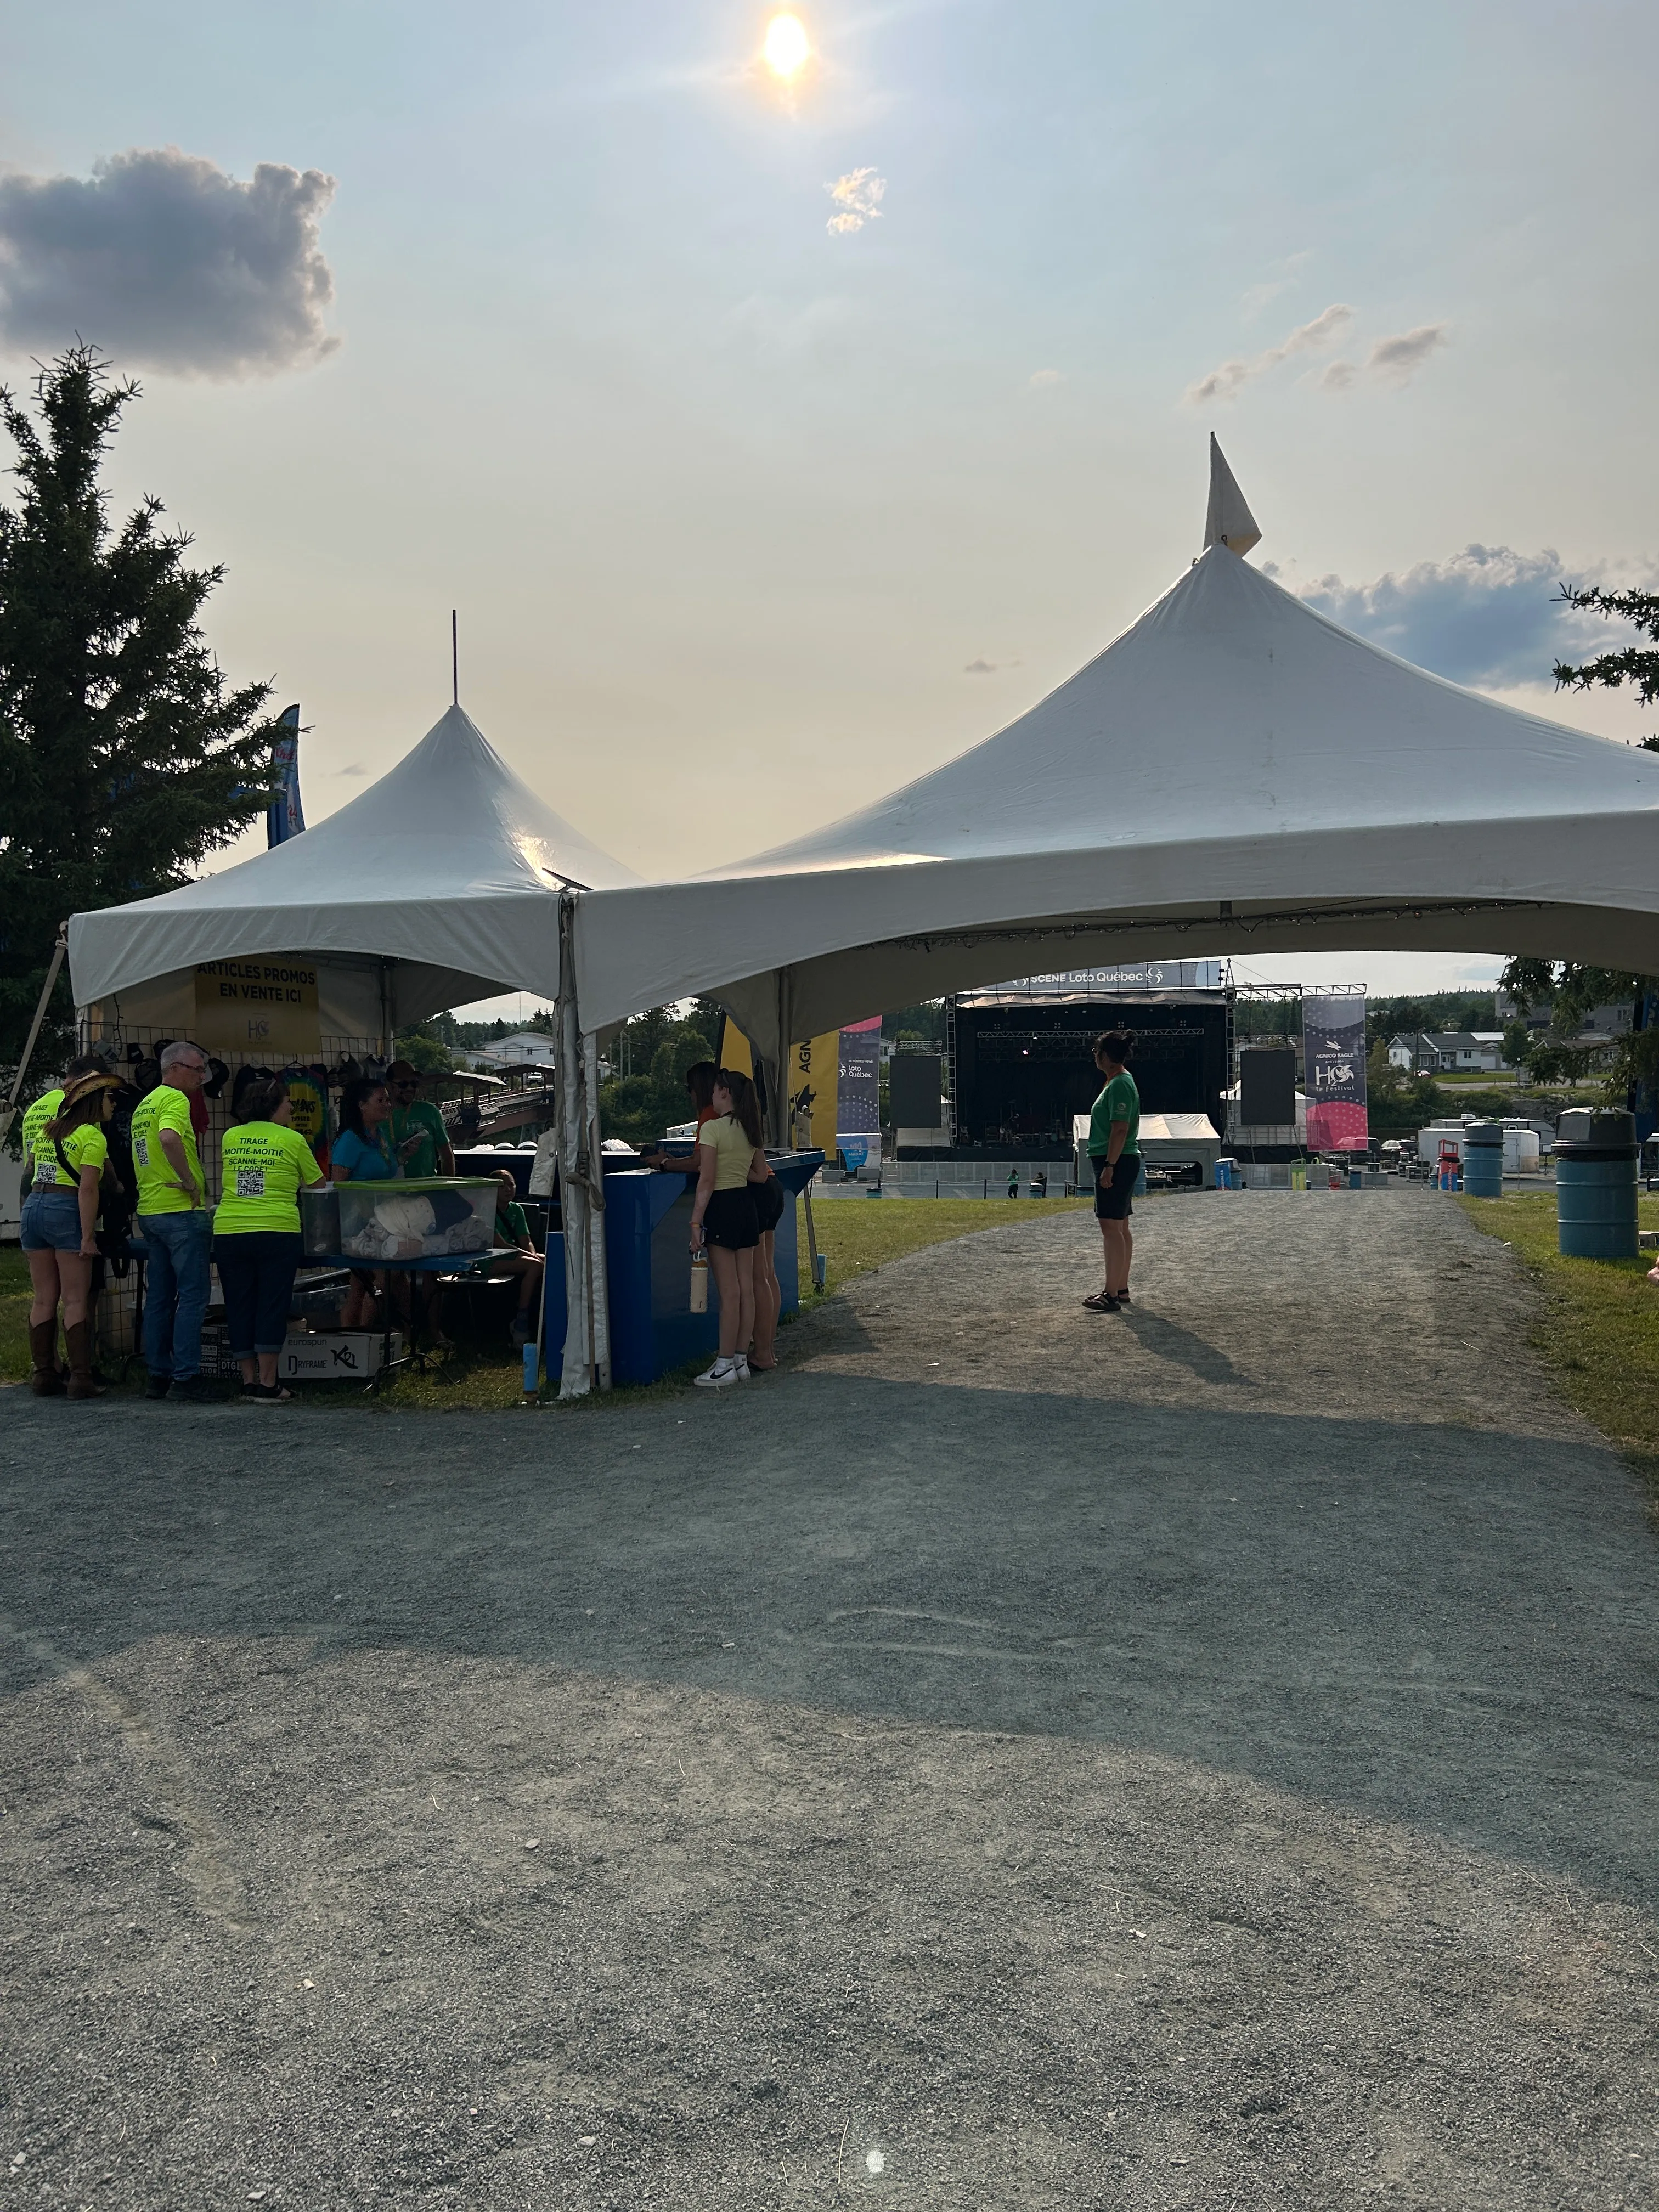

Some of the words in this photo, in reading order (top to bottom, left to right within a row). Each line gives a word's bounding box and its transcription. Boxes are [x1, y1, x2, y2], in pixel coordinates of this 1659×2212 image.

[197, 962, 261, 979] ARTICLES
[263, 967, 316, 985] PROMOS
[1069, 973, 1095, 983] Loto
[1096, 972, 1143, 983] Québec
[219, 983, 238, 997] EN
[241, 985, 283, 1001] VENTE
[286, 989, 301, 1003] ICI
[224, 1146, 284, 1158] MOITIÉ-MOITIÉ
[228, 1158, 275, 1166] SCANNE-MOI
[287, 1339, 328, 1347] eurospun
[288, 1355, 328, 1375] DRYFRAME
